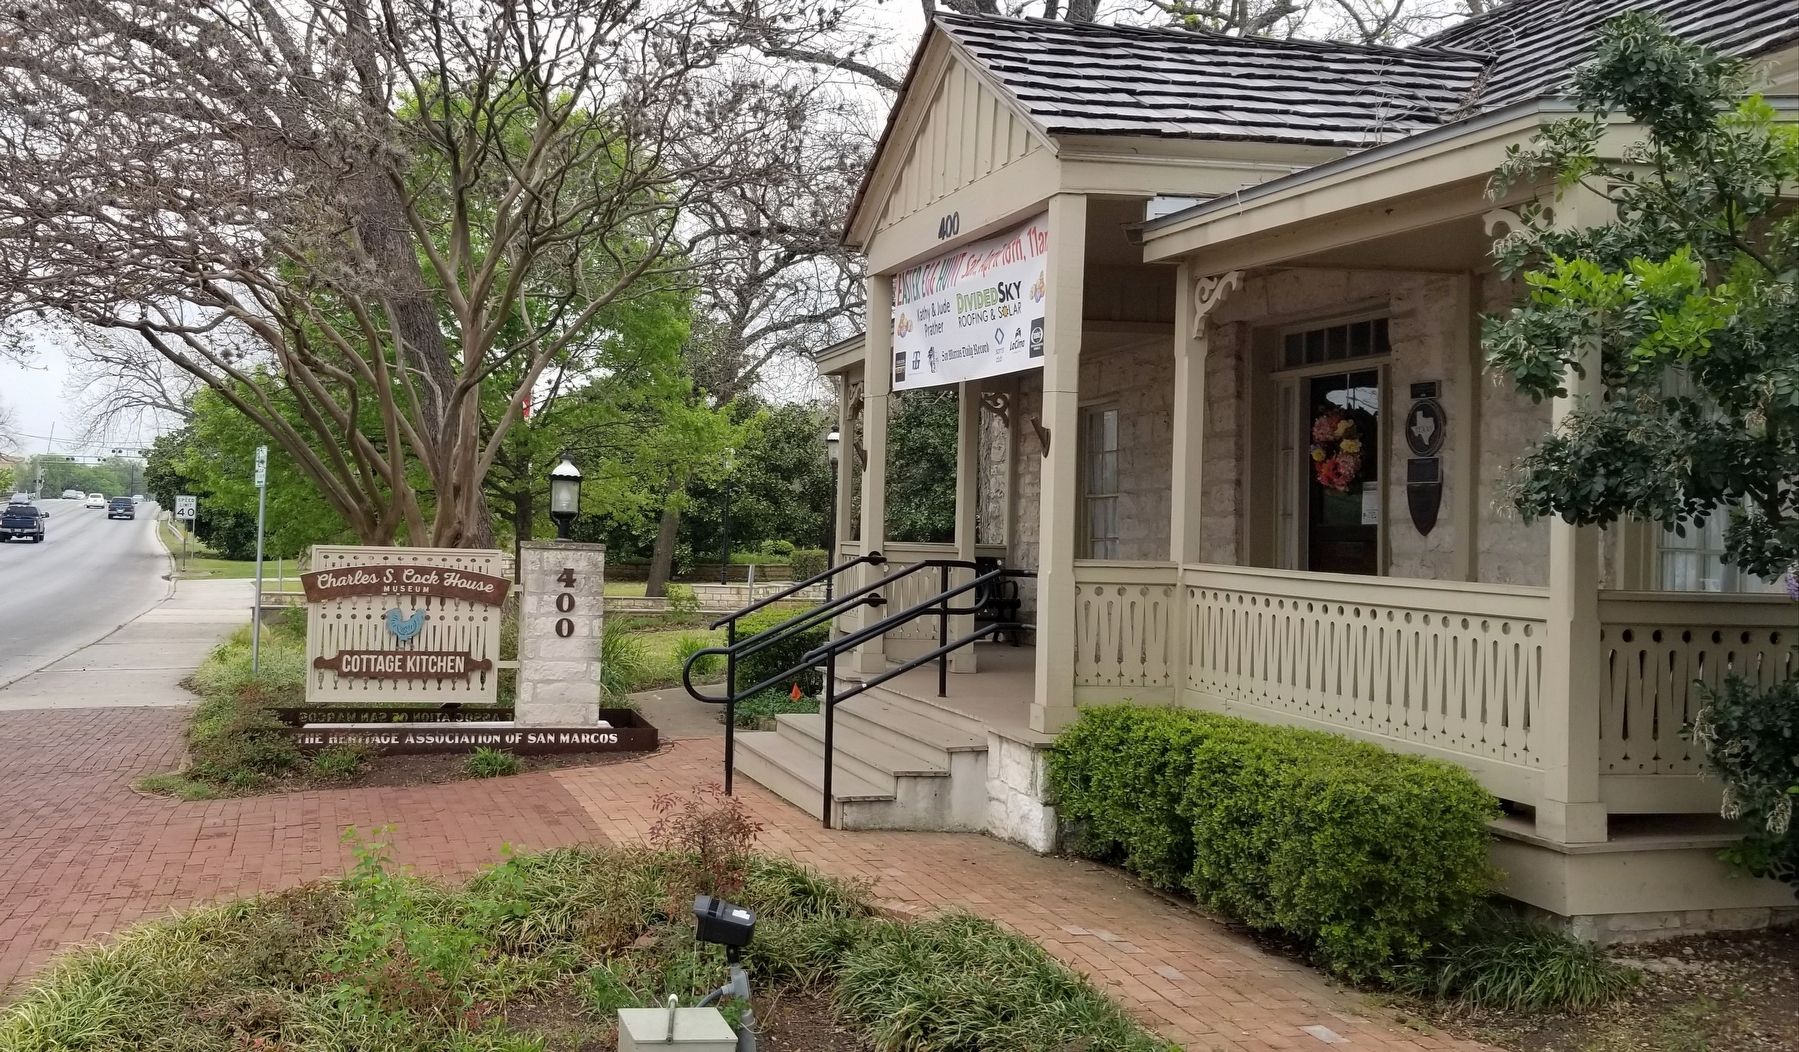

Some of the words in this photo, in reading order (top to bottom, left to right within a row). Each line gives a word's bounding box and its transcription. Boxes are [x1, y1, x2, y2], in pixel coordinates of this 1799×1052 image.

[938, 211, 960, 240] 400
[897, 266, 922, 307] EASTER
[922, 261, 941, 297] EGG
[931, 303, 937, 317] &
[958, 309, 988, 329] ROOFING
[990, 309, 996, 321] &
[177, 508, 195, 517] 40
[316, 568, 380, 590] Charles
[383, 568, 398, 583] S.
[402, 568, 440, 585] Cock
[443, 571, 495, 593] House
[383, 585, 430, 593] MUSEUM
[342, 655, 403, 673] COTTAGE
[406, 655, 465, 674] KITCHEN
[404, 732, 501, 744] ASSOCIATION
[505, 732, 524, 744] OF
[527, 732, 556, 744] SAN
[559, 732, 619, 744] MARCOS
